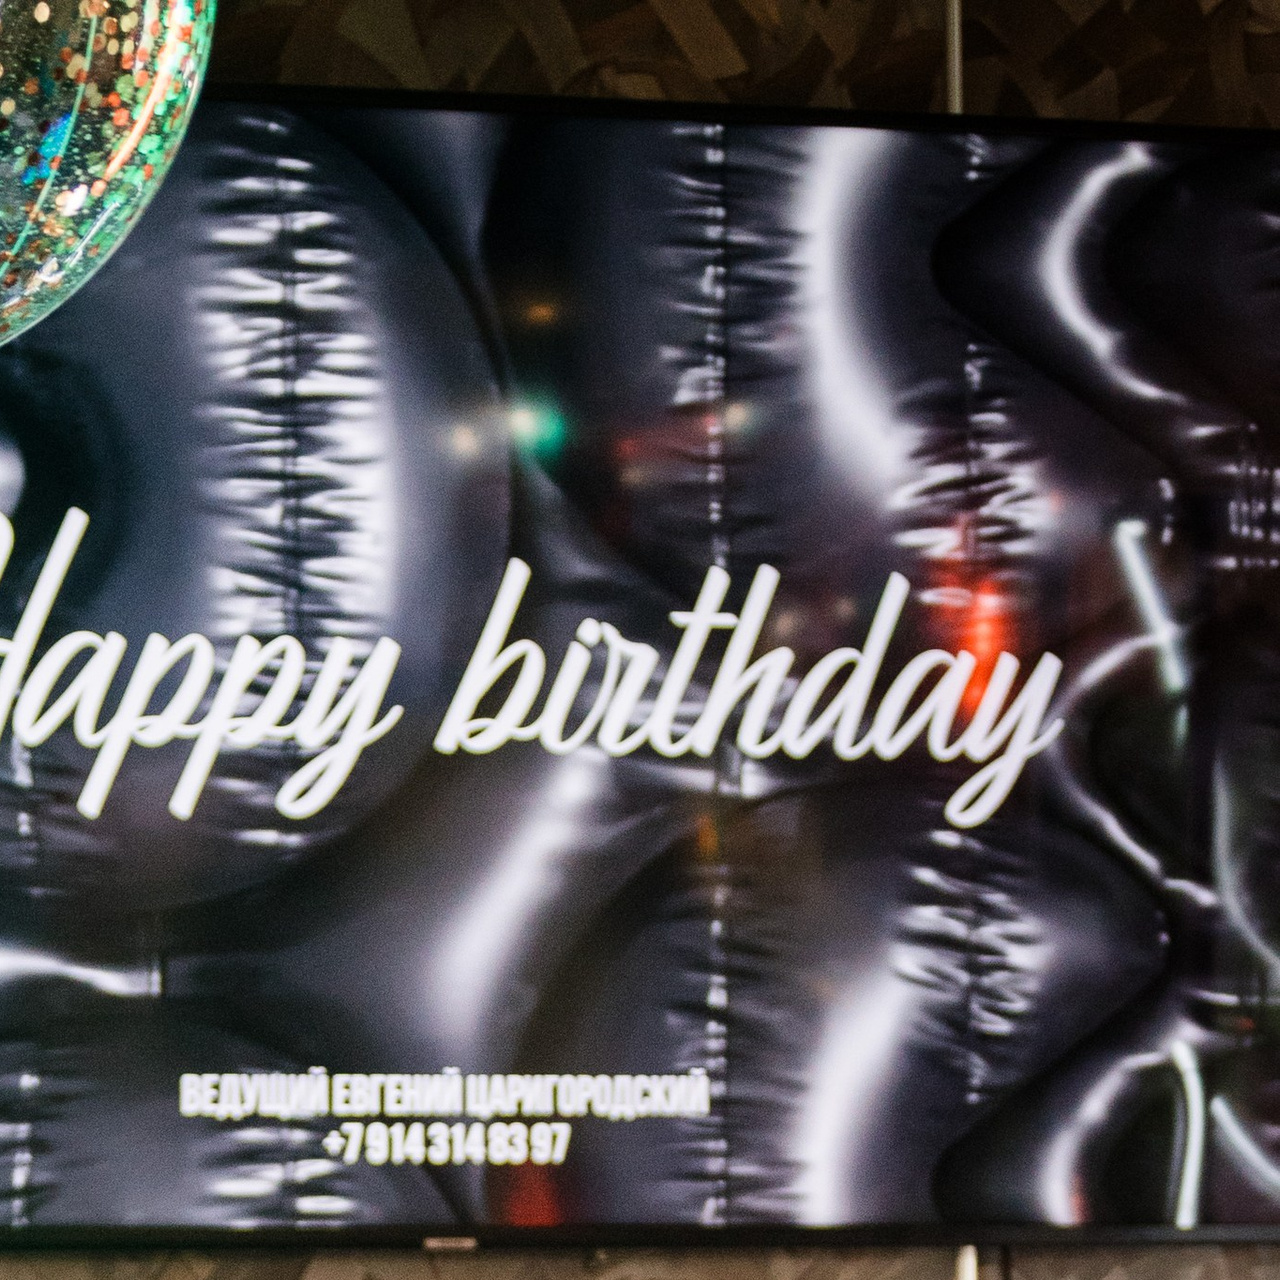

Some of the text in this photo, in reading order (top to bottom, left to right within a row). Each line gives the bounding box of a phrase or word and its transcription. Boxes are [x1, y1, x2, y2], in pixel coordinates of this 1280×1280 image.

[433, 556, 1065, 829] birthday
[178, 1065, 711, 1121] ВЕДУЩИЙ ЕВГЕНИЙ ЦАРИГОРОДСКИЙ
